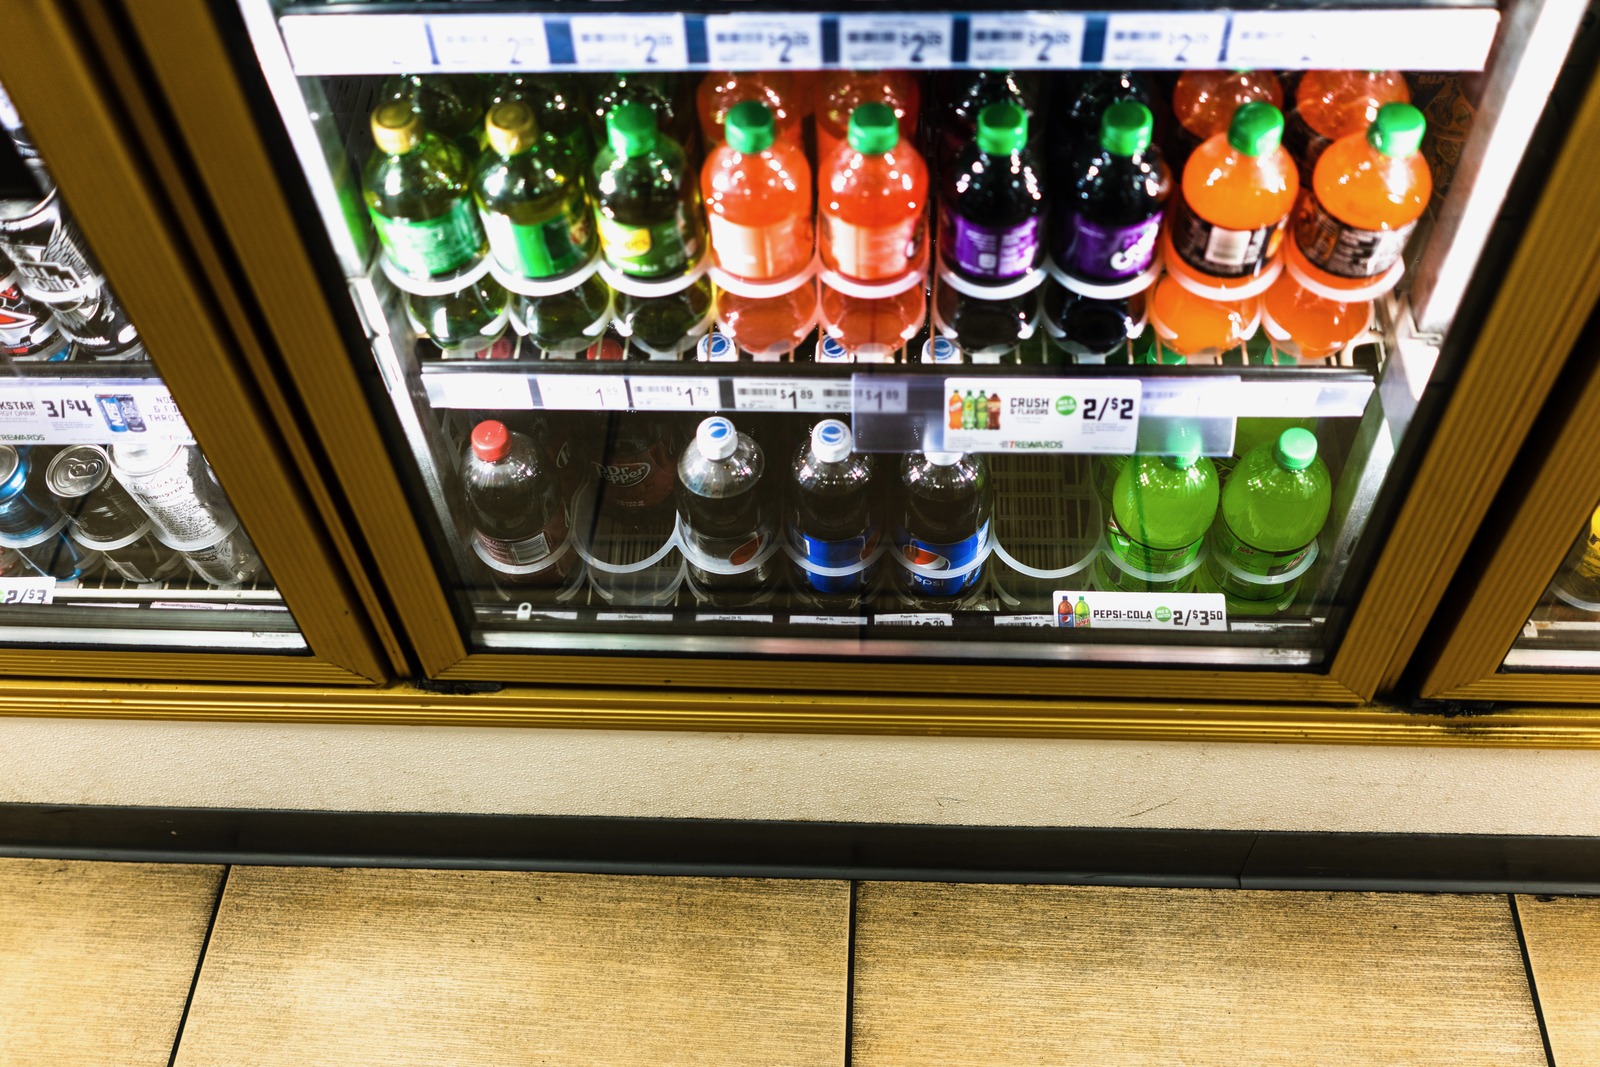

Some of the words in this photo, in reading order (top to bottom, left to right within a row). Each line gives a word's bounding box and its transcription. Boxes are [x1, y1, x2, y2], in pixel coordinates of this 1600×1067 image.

[1010, 397, 1050, 408] CRUSH
[1082, 397, 1134, 421] 2/$2
[1093, 609, 1153, 620] PEPSI-COLA
